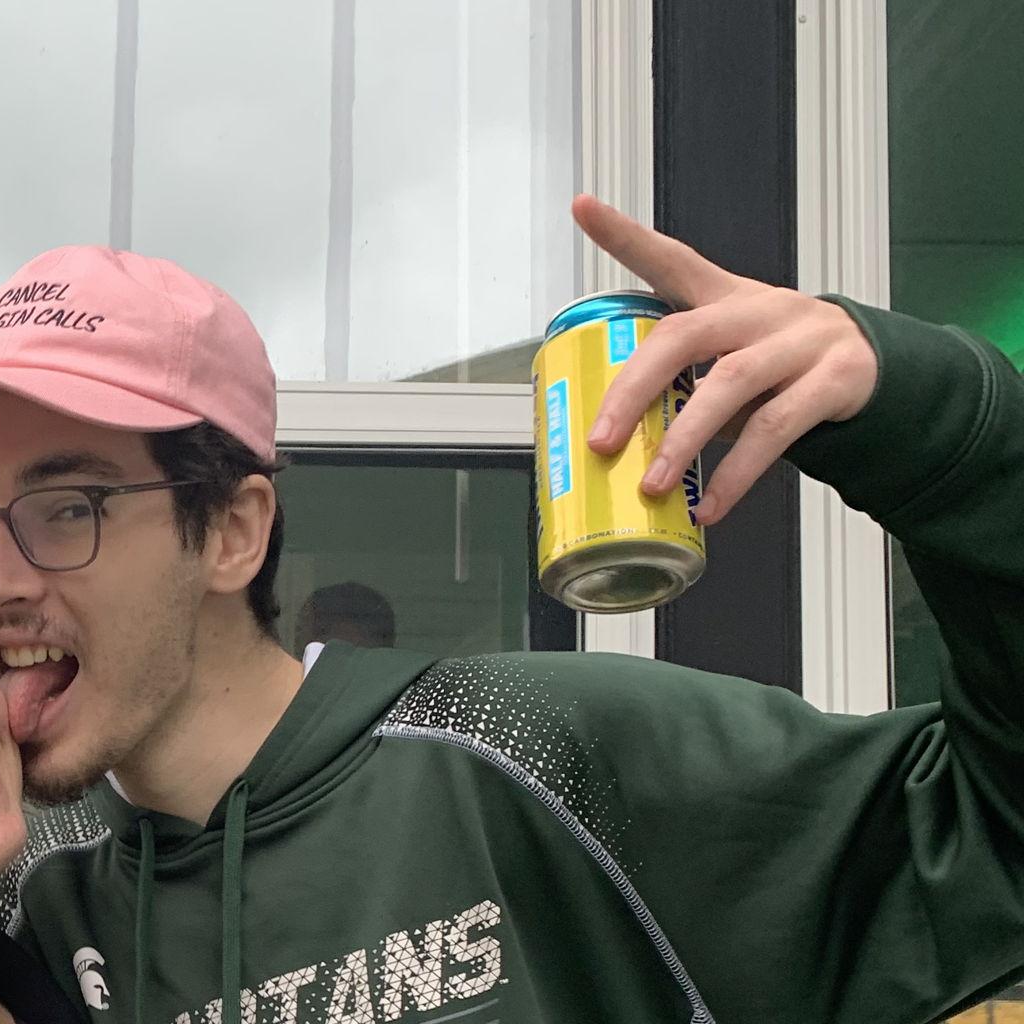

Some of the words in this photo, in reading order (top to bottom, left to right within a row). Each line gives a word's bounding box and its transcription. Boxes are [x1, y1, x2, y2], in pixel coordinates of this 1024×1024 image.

[34, 308, 105, 333] CALLS
[547, 389, 561, 432] HALF
[549, 453, 565, 498] HALF
